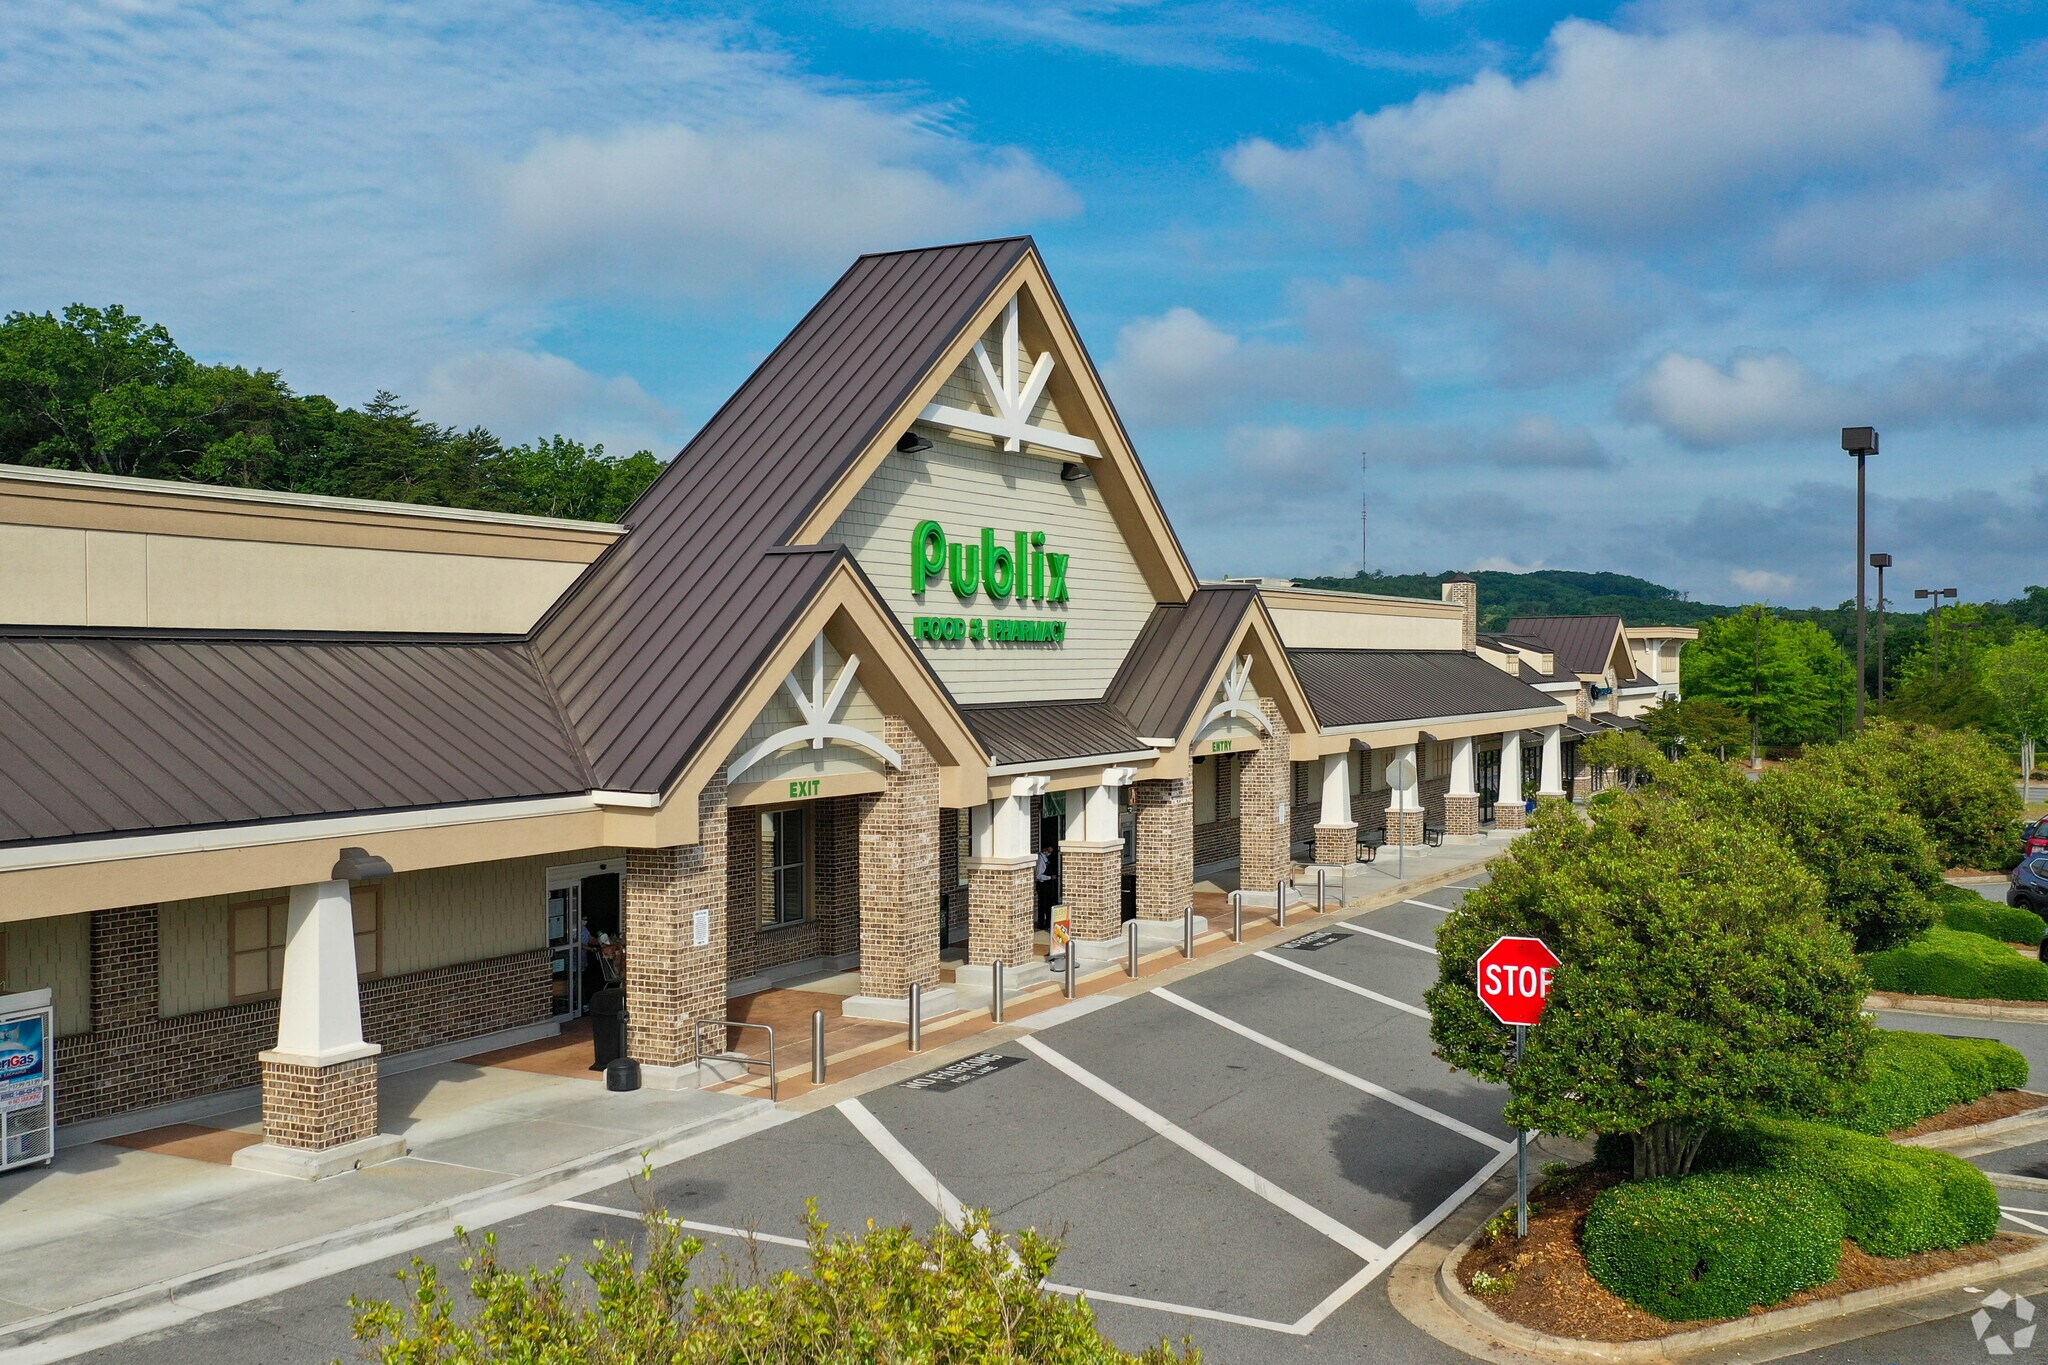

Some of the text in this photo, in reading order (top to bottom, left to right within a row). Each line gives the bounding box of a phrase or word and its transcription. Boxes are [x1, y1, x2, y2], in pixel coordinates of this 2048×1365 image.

[911, 520, 1069, 602] Publix
[913, 617, 1067, 642] FOOD & PHARMACY
[1212, 740, 1232, 752] ENTRY
[790, 780, 820, 797] EXIT
[899, 1053, 1003, 1089] NO PARKING
